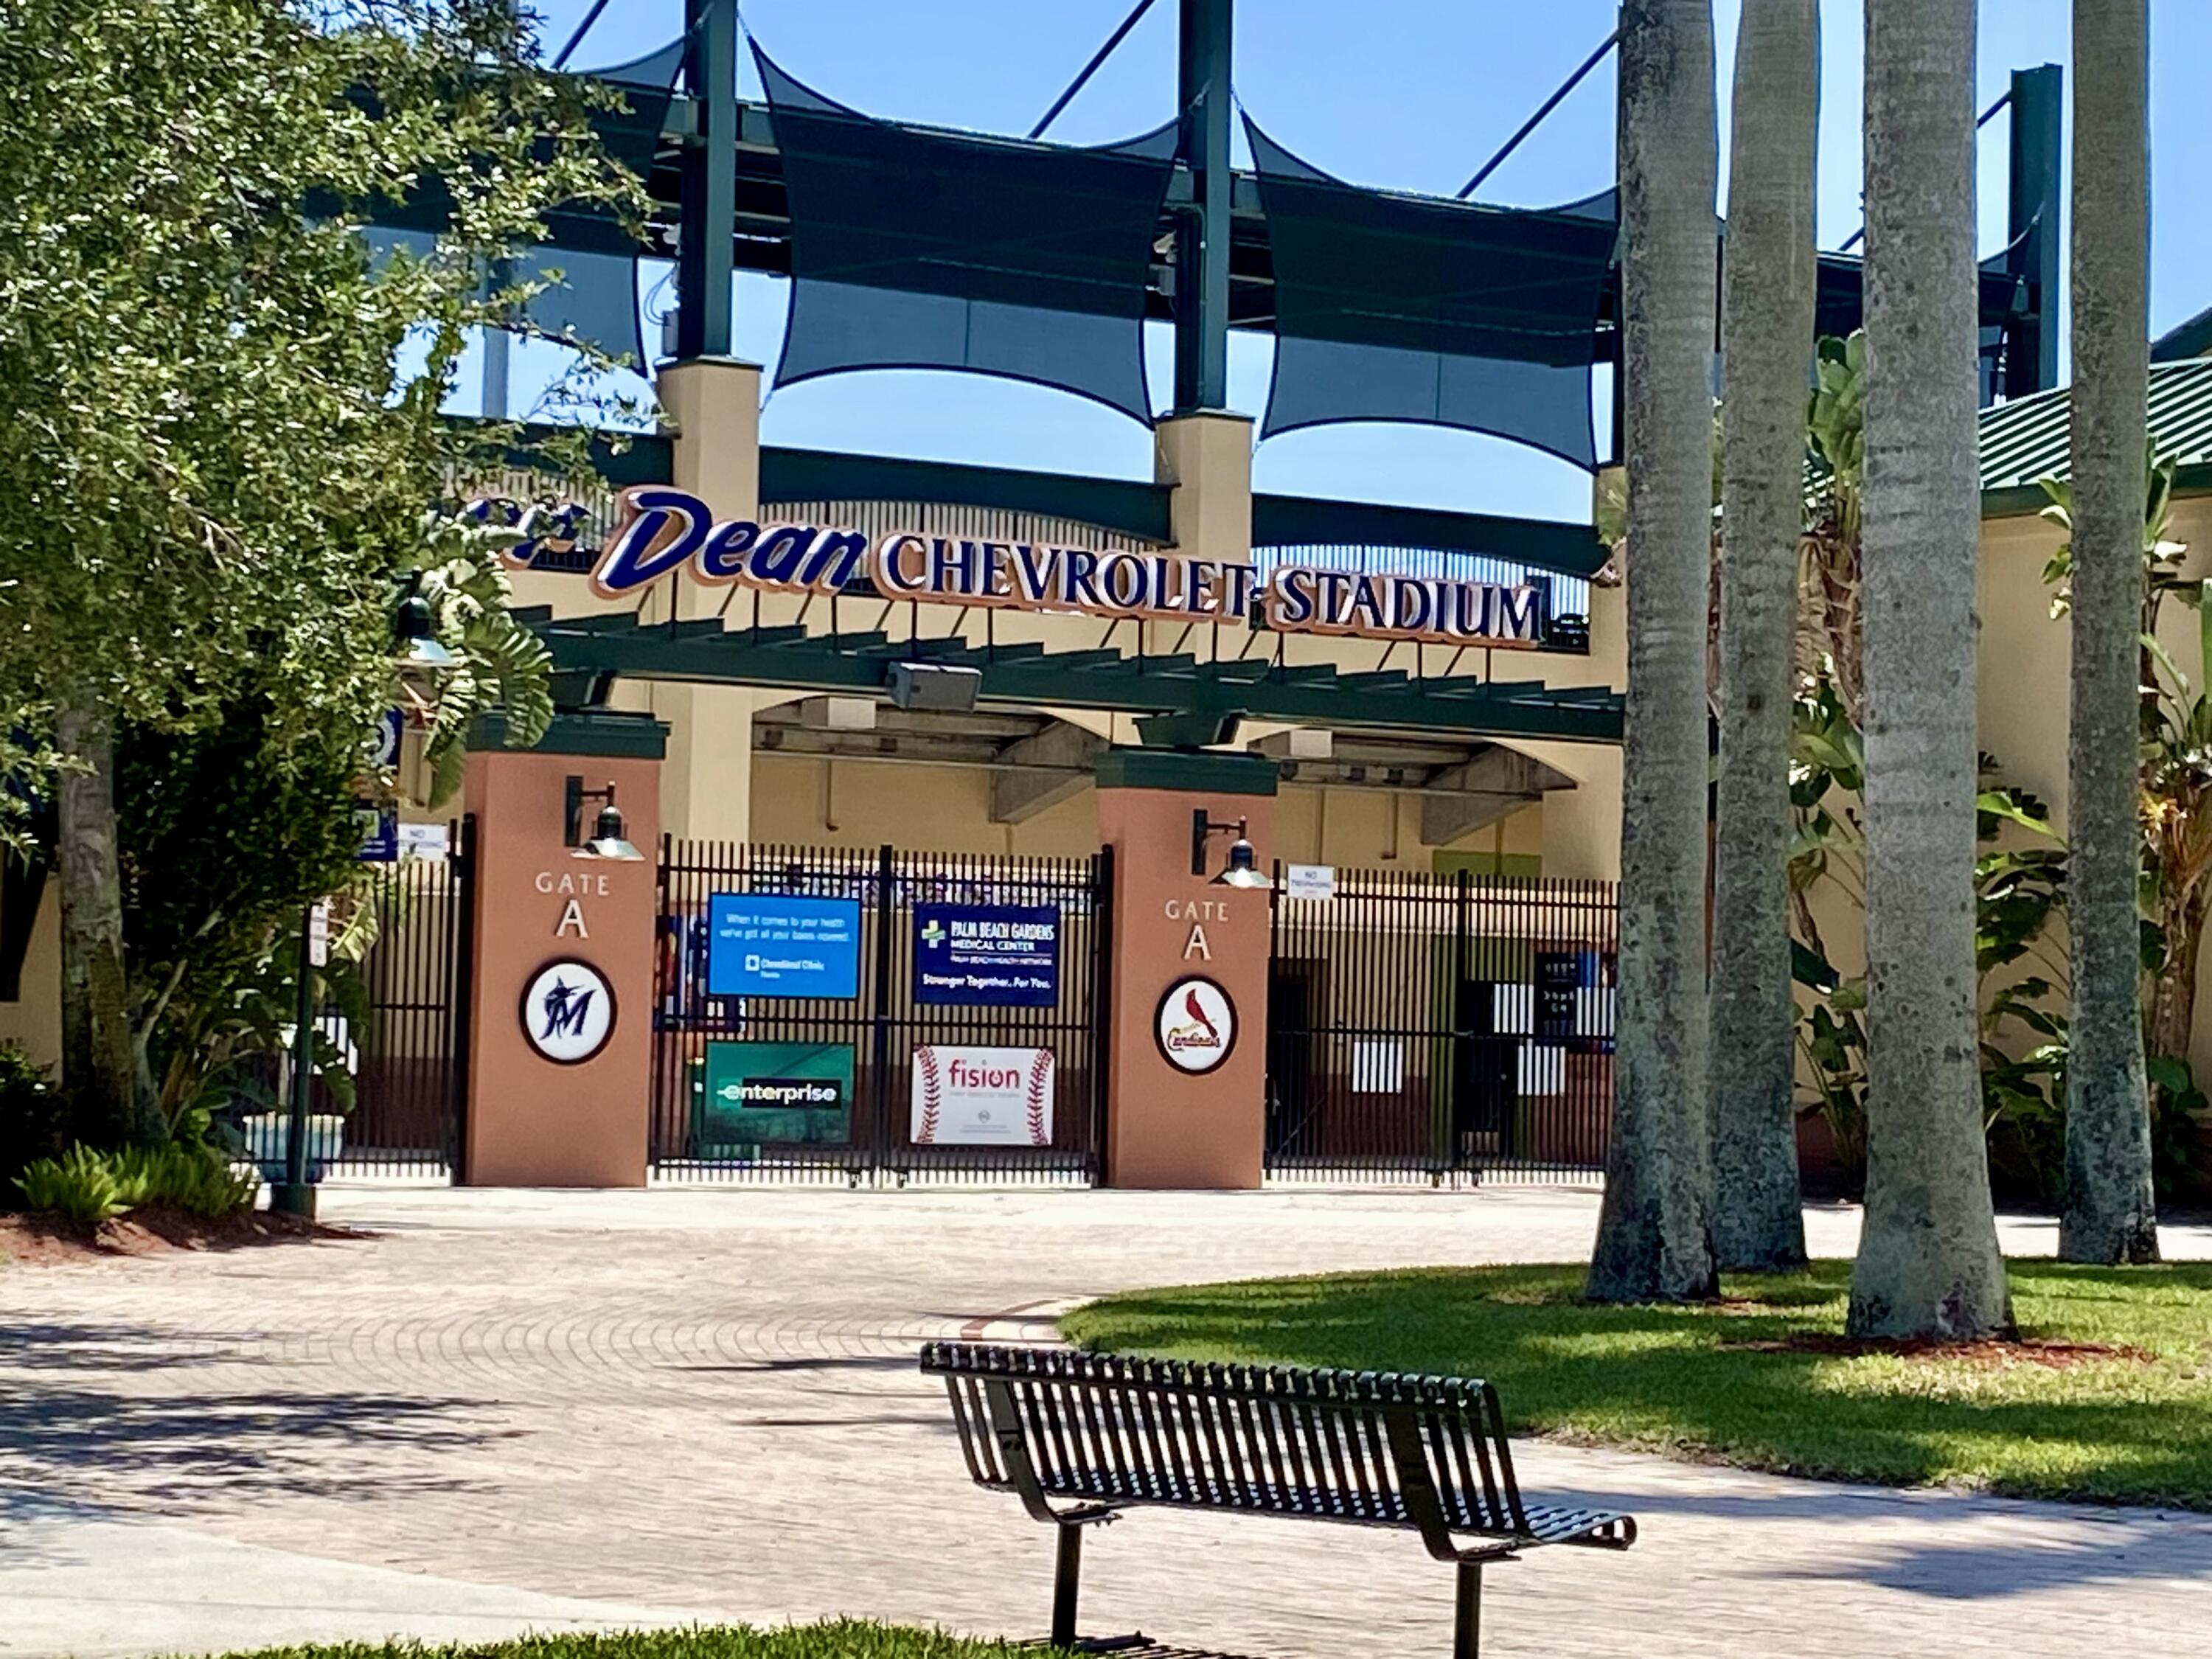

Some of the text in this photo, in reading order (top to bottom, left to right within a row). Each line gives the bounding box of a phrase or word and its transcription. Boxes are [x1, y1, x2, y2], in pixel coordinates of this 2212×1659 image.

[594, 487, 868, 593] Dean
[882, 532, 1258, 618] CHEVROLET
[1271, 565, 1541, 643] STADIUM
[535, 871, 609, 897] GATE
[557, 900, 588, 939] A
[1165, 900, 1228, 922] GATE
[950, 920, 1055, 941] PALM BEACH GARDENS
[1183, 924, 1211, 960] A
[950, 939, 1035, 952] MEDICAL CENTER
[923, 973, 966, 989] Stronger
[538, 989, 596, 1040] M
[948, 1059, 1020, 1089] fision
[717, 1083, 837, 1105] enterprise
